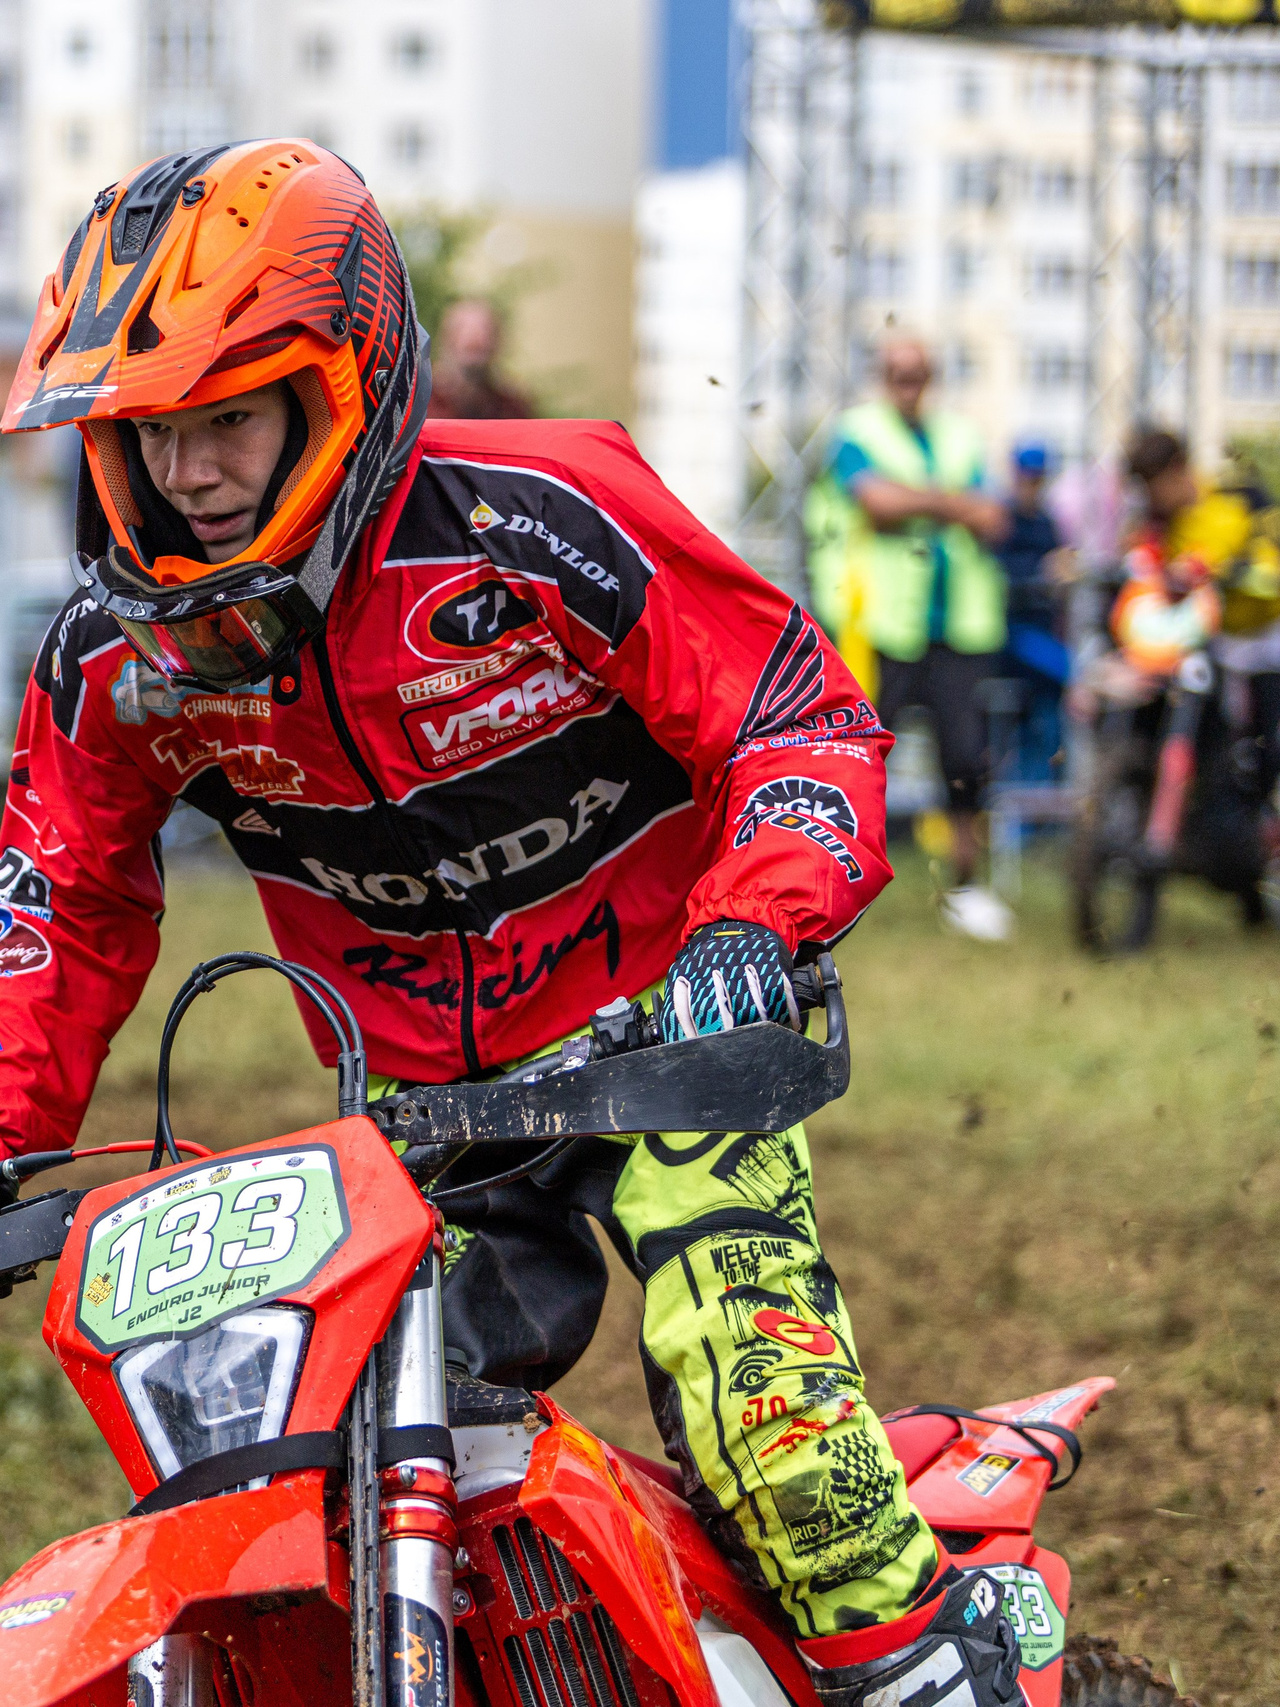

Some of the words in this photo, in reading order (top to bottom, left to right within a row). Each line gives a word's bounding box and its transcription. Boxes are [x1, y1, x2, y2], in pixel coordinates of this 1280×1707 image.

[58, 597, 99, 651] DUN
[402, 655, 502, 700] THROTTLE
[420, 662, 583, 751] VFORC
[432, 740, 483, 766] REED
[486, 713, 545, 742] VALVE
[549, 680, 600, 716] SYSTE
[769, 733, 810, 748] Club
[814, 732, 834, 743] of
[840, 720, 886, 739] Ameri
[301, 778, 630, 906] HONDA
[107, 1175, 307, 1320] 133
[709, 1239, 795, 1274] WELCOME
[126, 1290, 194, 1330] ENDURO
[197, 1273, 271, 1298] JUNIOR
[177, 1305, 203, 1325] J2
[1003, 1583, 1053, 1637] 33
